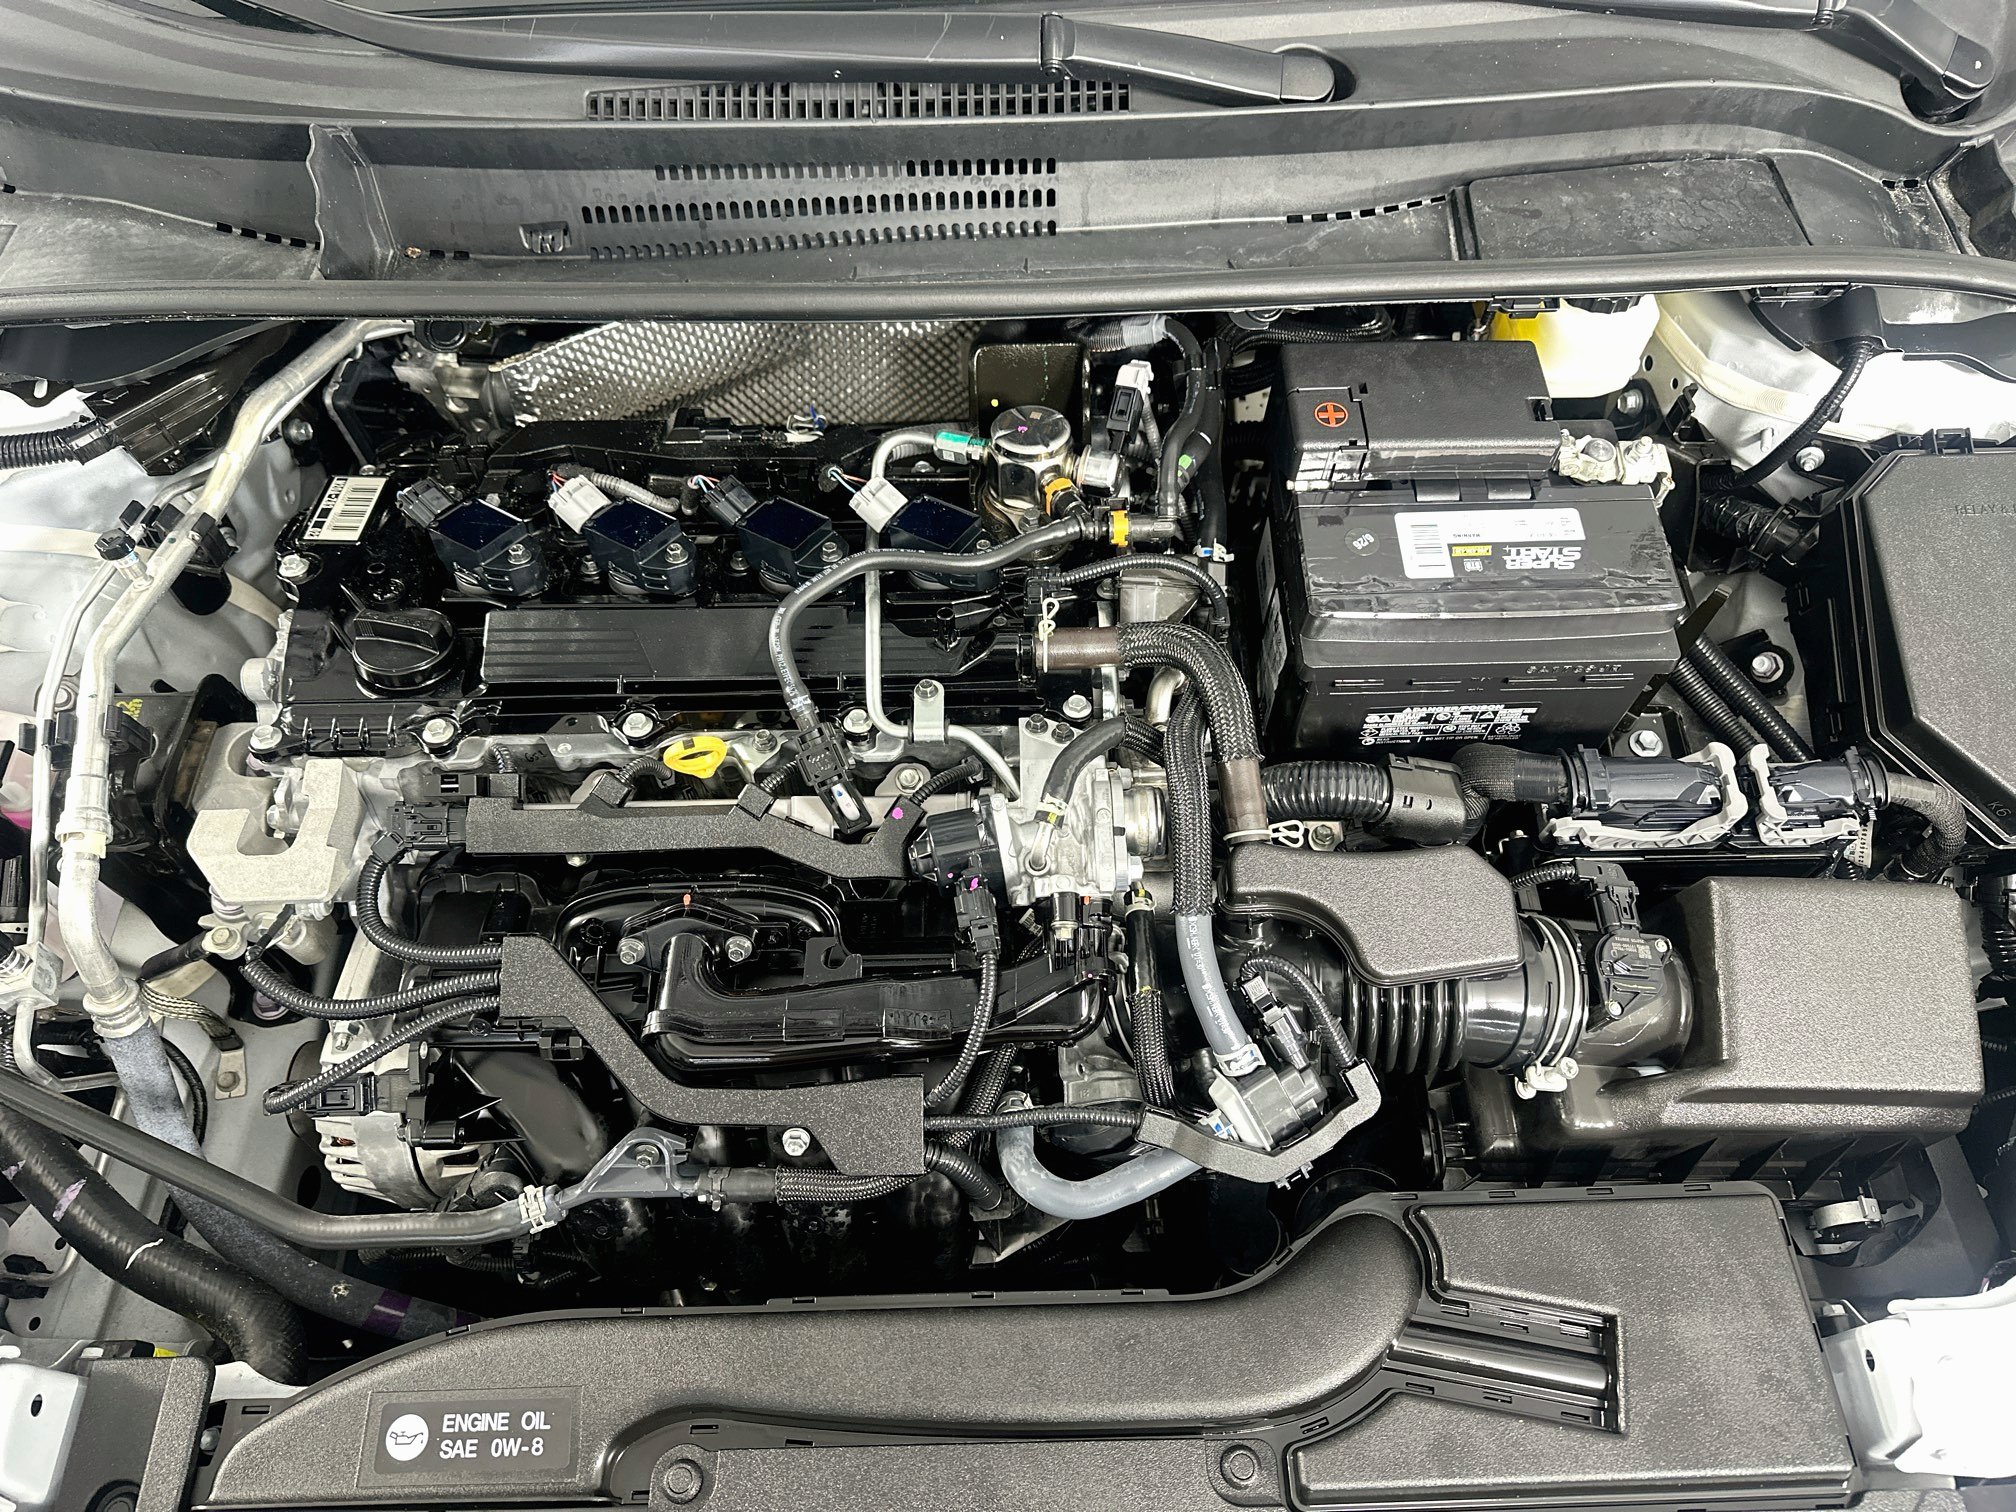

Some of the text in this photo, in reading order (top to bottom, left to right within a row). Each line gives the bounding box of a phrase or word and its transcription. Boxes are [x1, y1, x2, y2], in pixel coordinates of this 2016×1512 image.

[1955, 504, 1996, 514] RELAY
[1352, 533, 1375, 550] 6/26
[1505, 558, 1576, 570] SUPER
[442, 1411, 551, 1433] ENGINE OIL
[439, 1437, 544, 1459] SAE 0W-8
